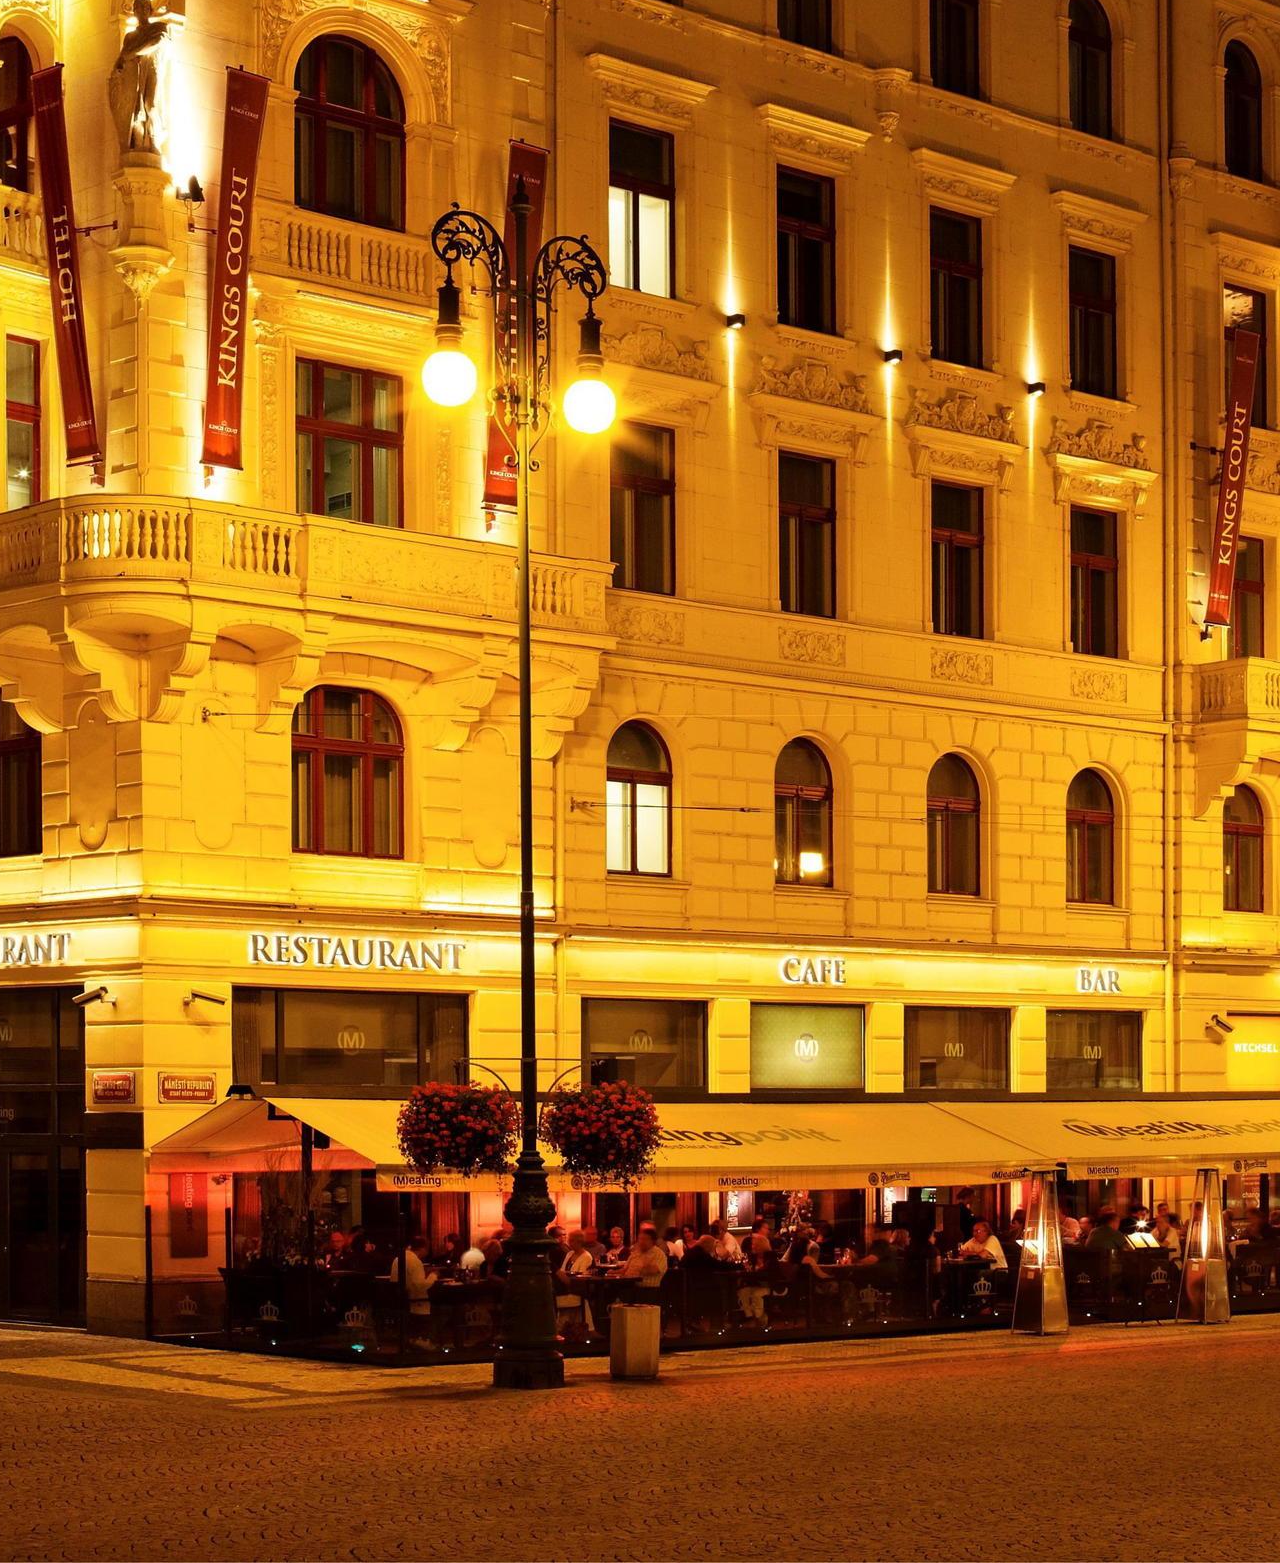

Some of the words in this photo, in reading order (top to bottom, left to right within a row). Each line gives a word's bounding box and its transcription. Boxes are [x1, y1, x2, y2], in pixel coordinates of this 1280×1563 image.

[225, 168, 251, 276] COURT
[53, 205, 77, 326] HOTEL
[216, 284, 242, 389] KINGS
[1228, 401, 1248, 482] COURT
[1219, 489, 1239, 566] KINGS
[250, 933, 467, 971] RESTAURANT
[782, 957, 847, 985] CAFE
[1079, 968, 1122, 993] BAR
[1233, 1042, 1280, 1054] WECHSEL
